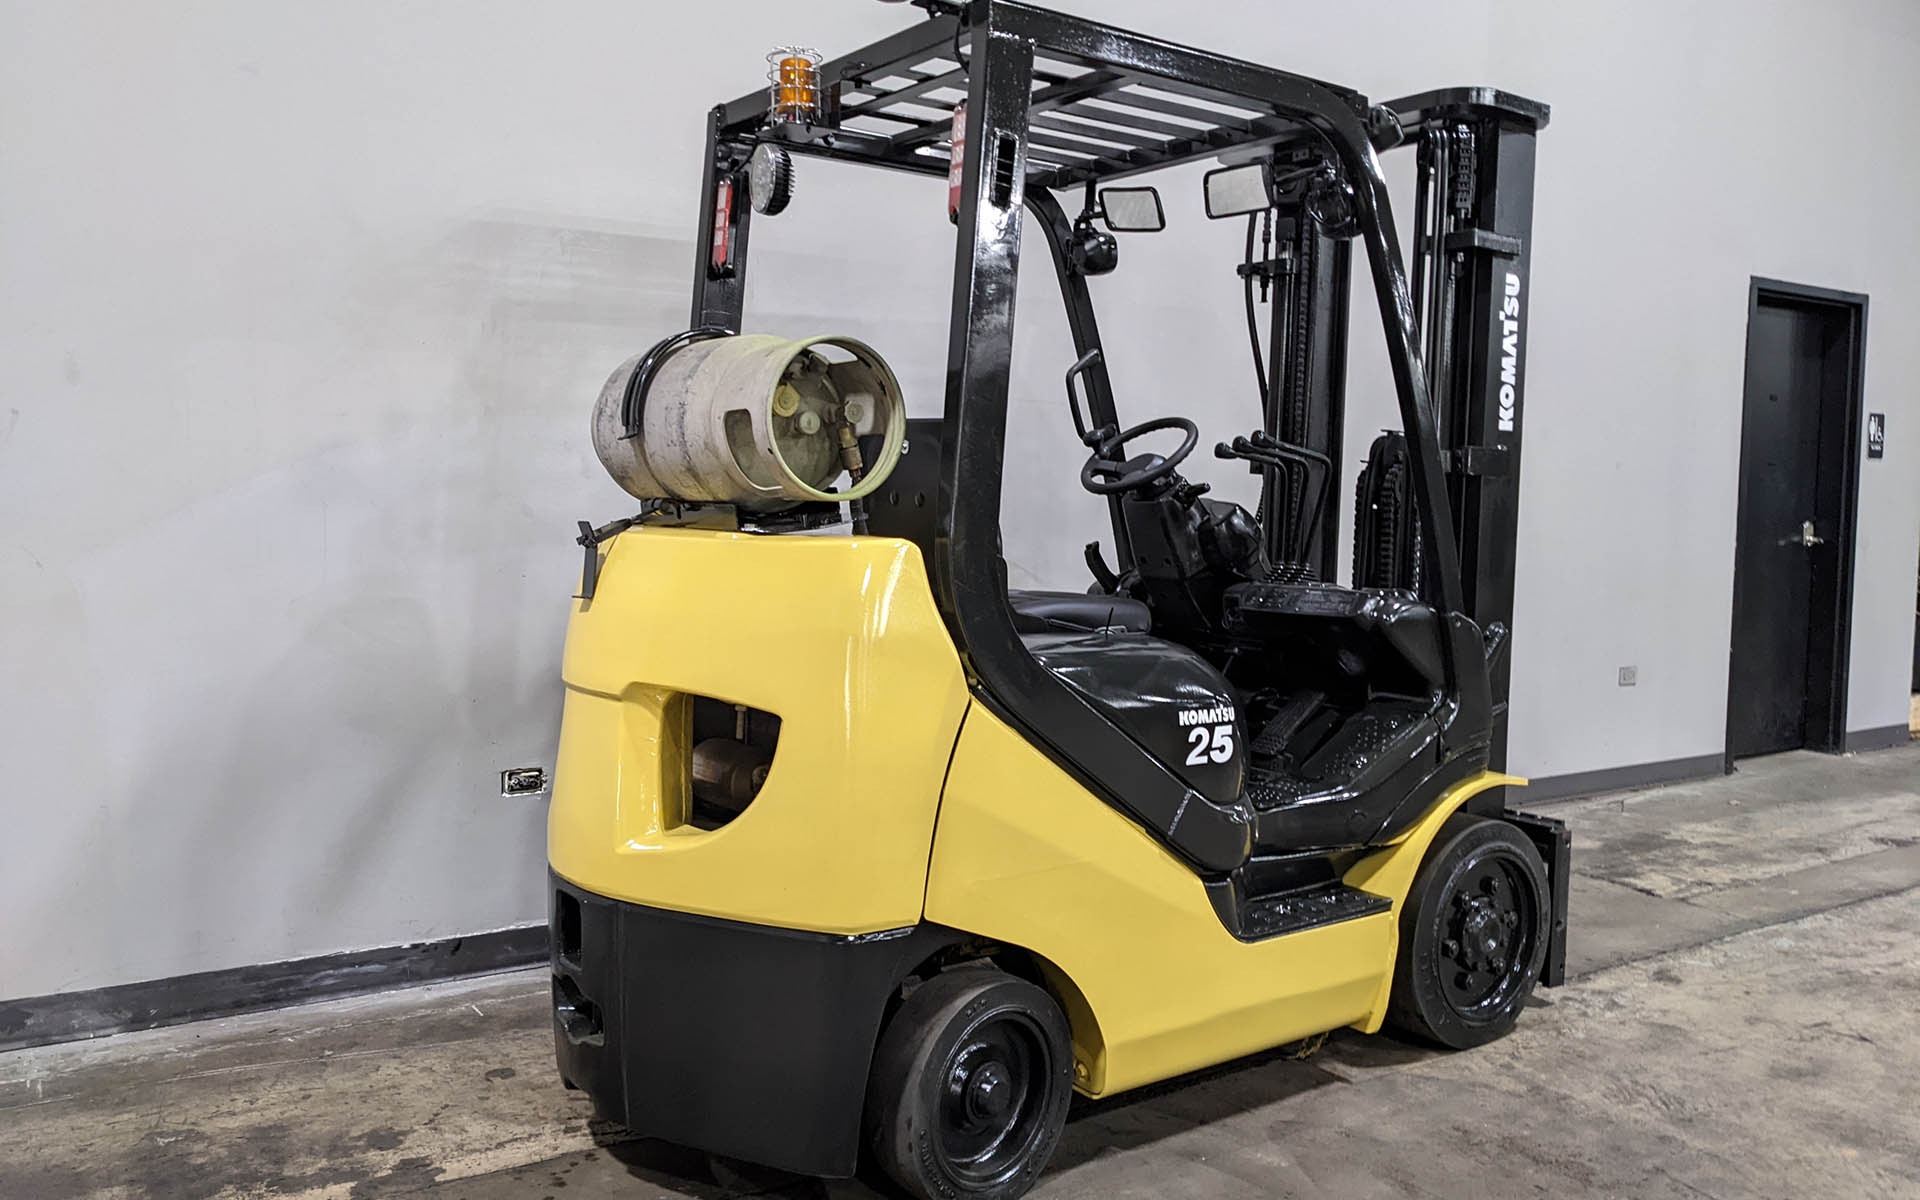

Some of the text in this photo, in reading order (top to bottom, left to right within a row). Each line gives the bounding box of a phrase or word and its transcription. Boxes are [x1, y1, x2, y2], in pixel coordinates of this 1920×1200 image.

[1498, 273, 1520, 432] KOMATSU
[1178, 705, 1235, 726] KOMATSU
[1185, 725, 1234, 766] 25
